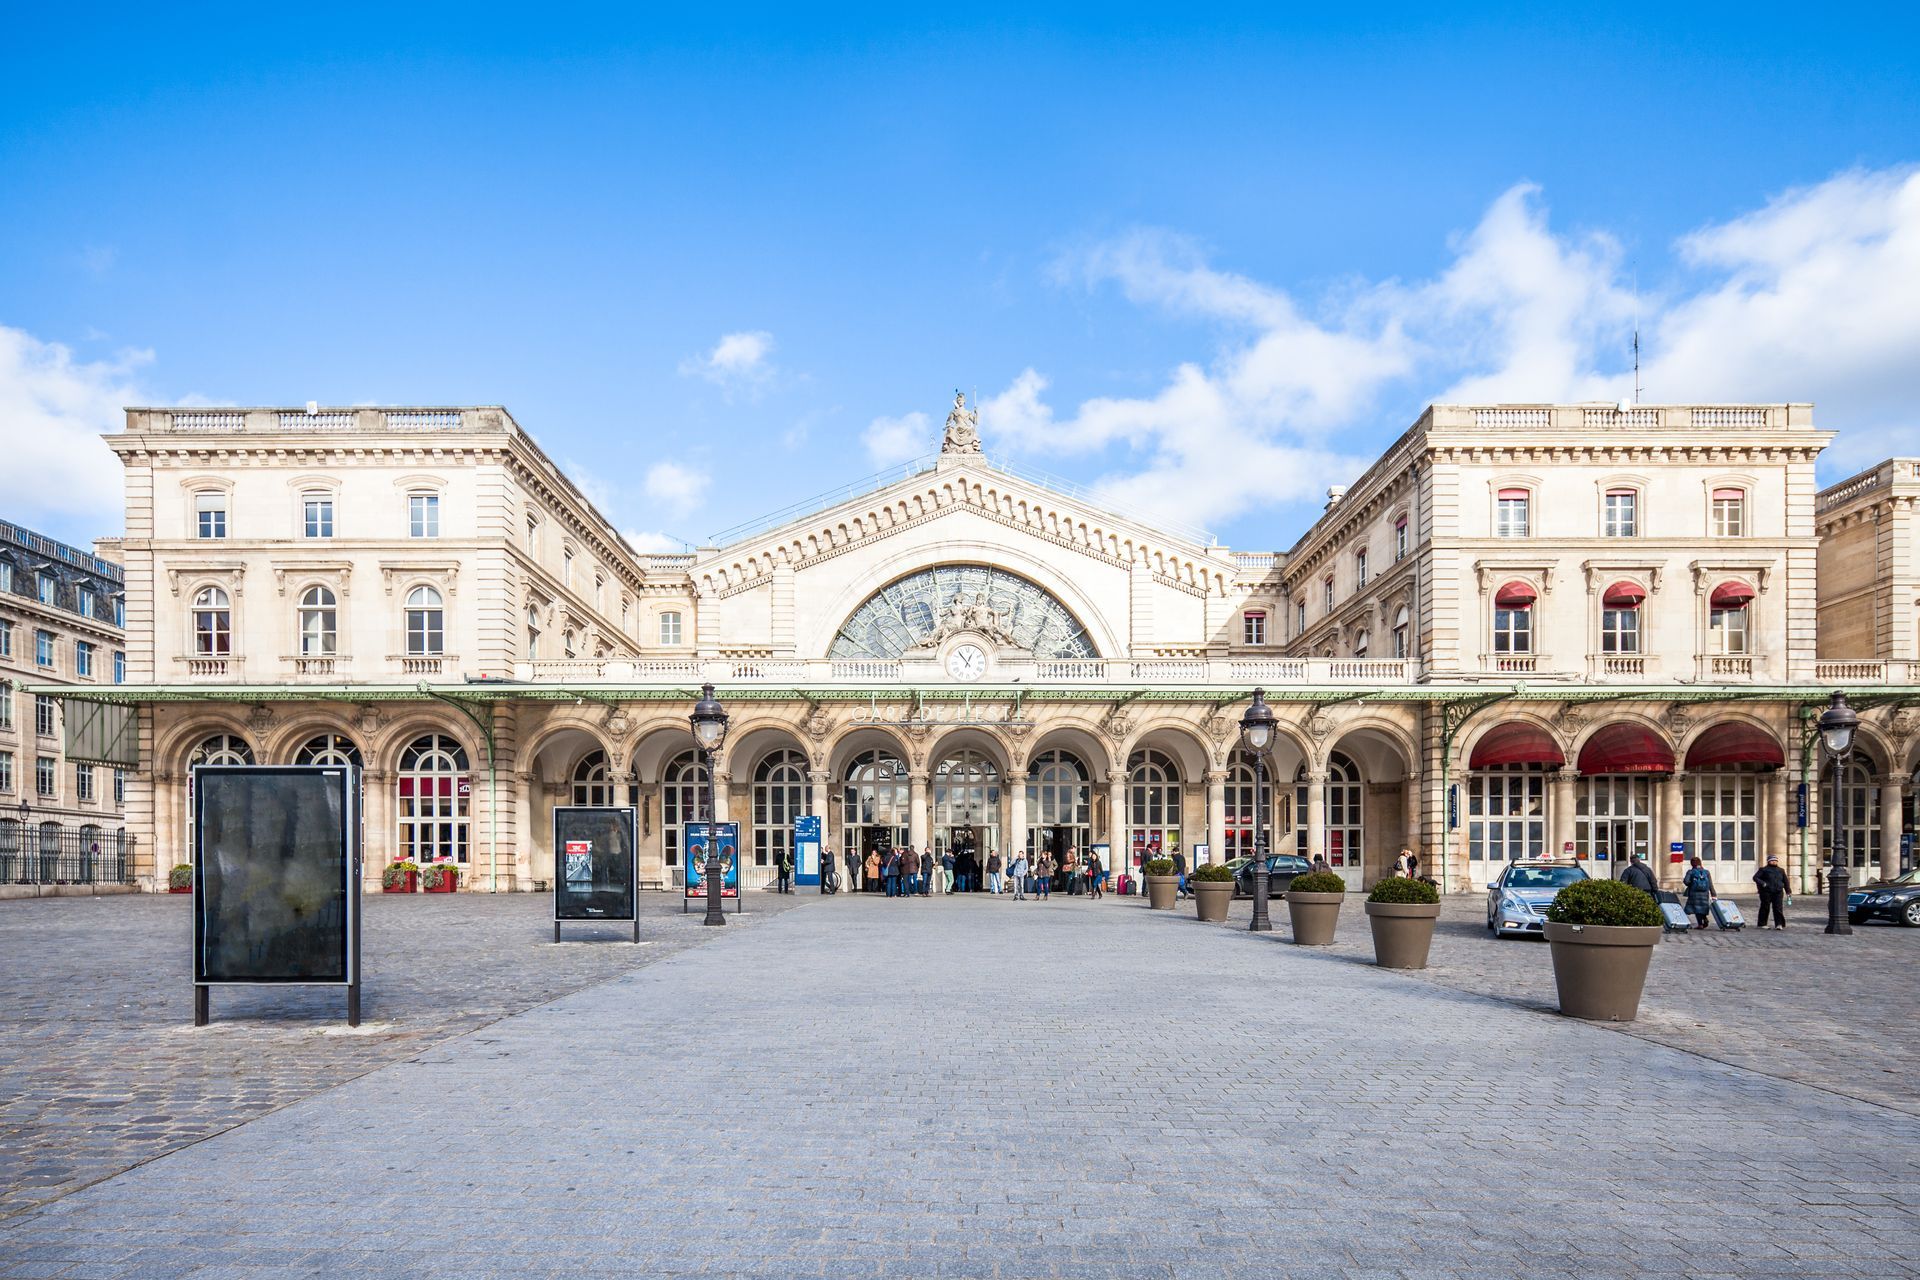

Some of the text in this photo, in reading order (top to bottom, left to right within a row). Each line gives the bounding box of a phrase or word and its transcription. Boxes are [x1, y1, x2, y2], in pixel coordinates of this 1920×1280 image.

[852, 706, 1011, 722] GARE DE L'EST
